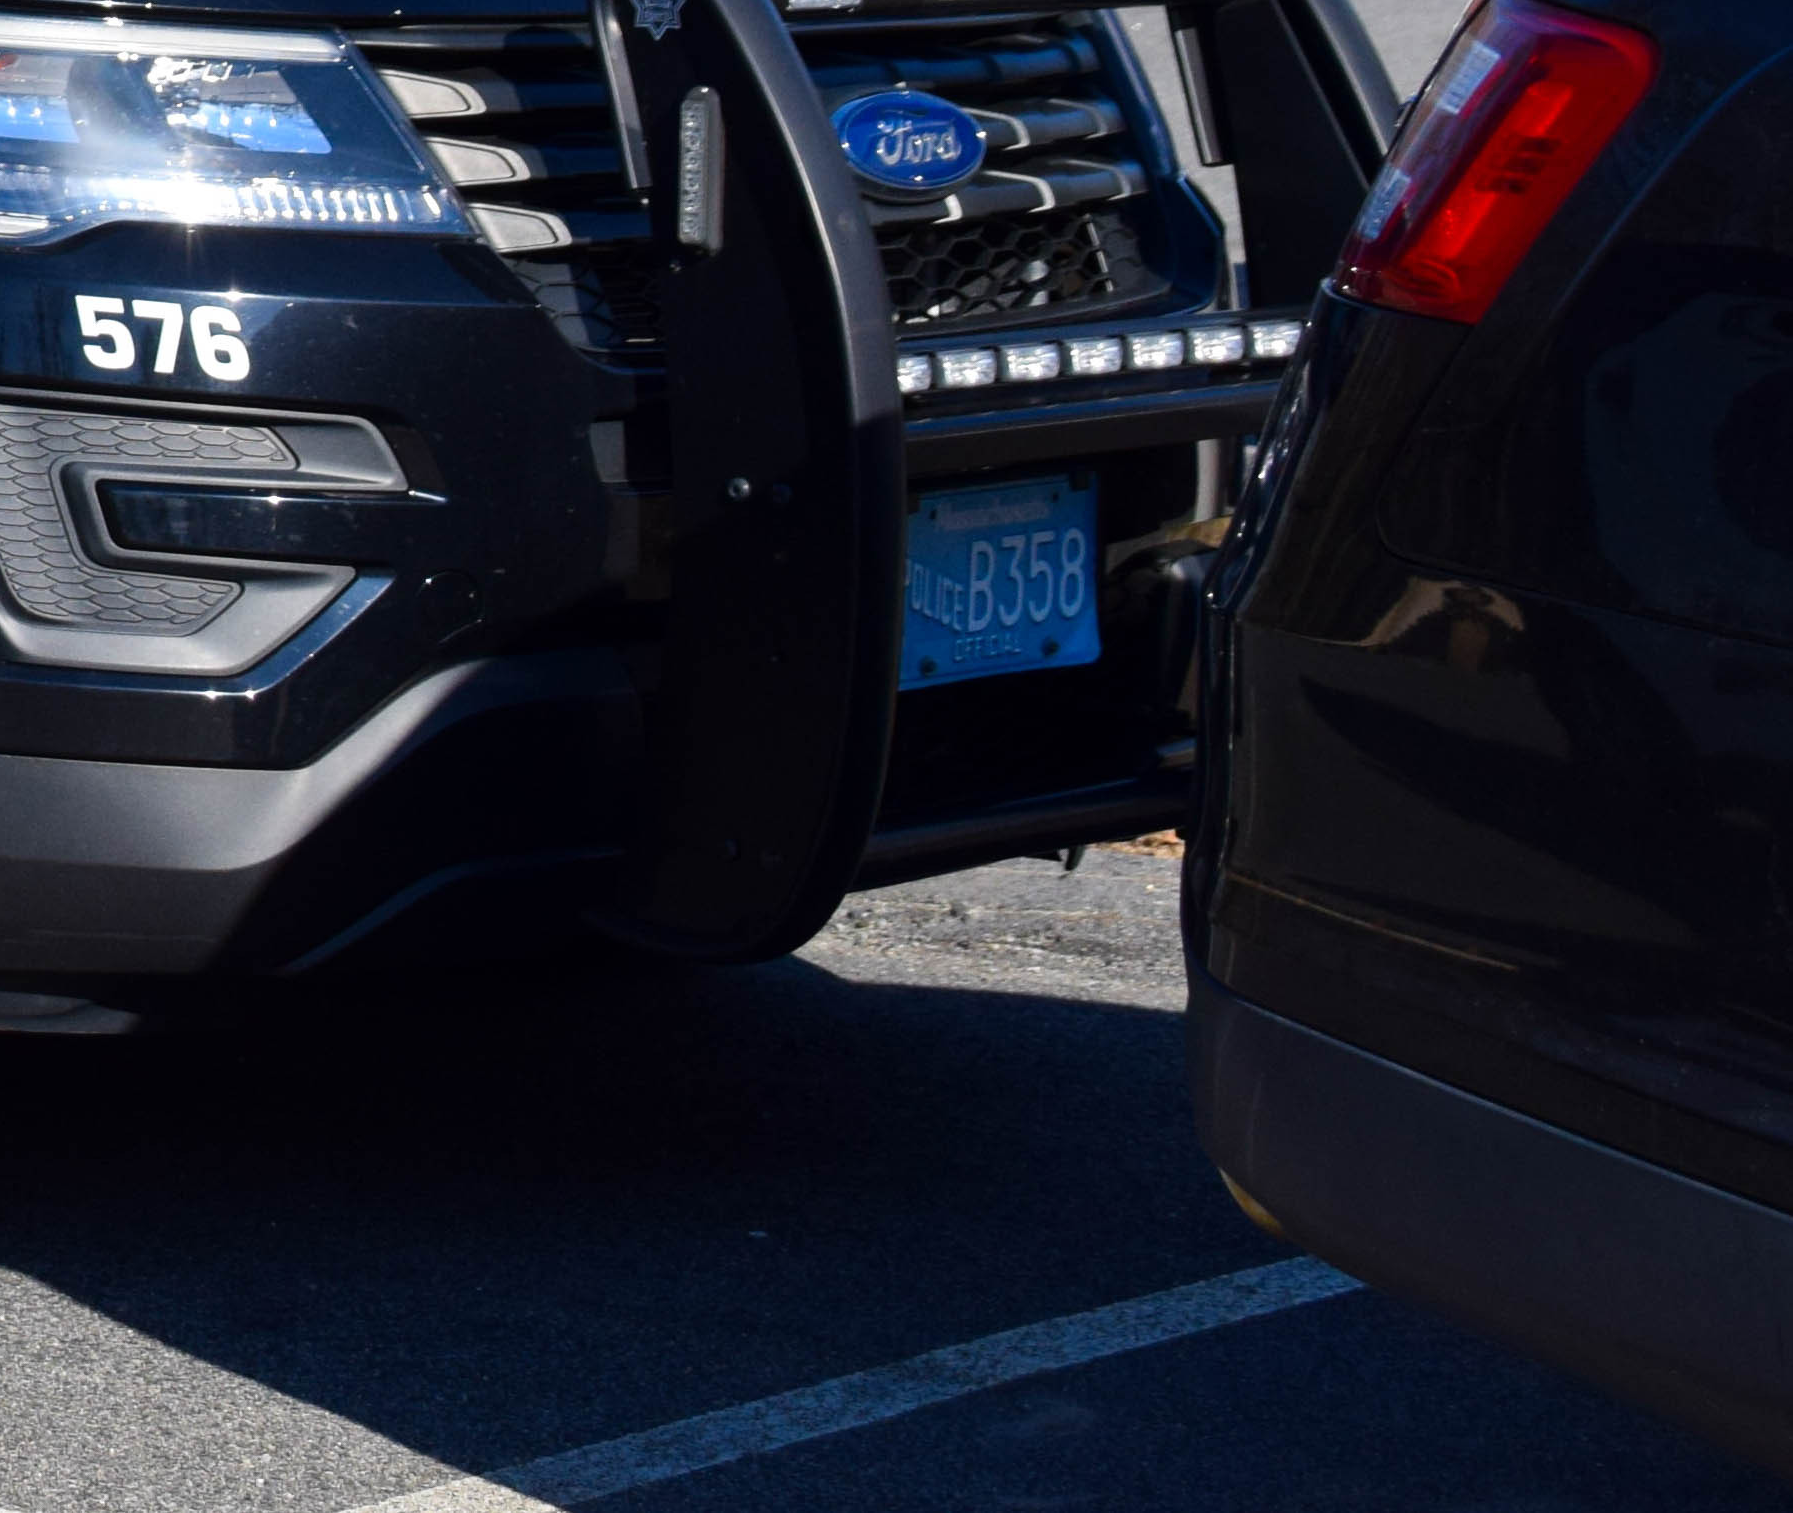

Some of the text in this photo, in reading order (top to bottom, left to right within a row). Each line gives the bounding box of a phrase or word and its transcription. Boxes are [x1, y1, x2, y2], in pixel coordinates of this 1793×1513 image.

[876, 118, 963, 166] Ford
[73, 294, 251, 382] 576
[967, 528, 1086, 633] B358
